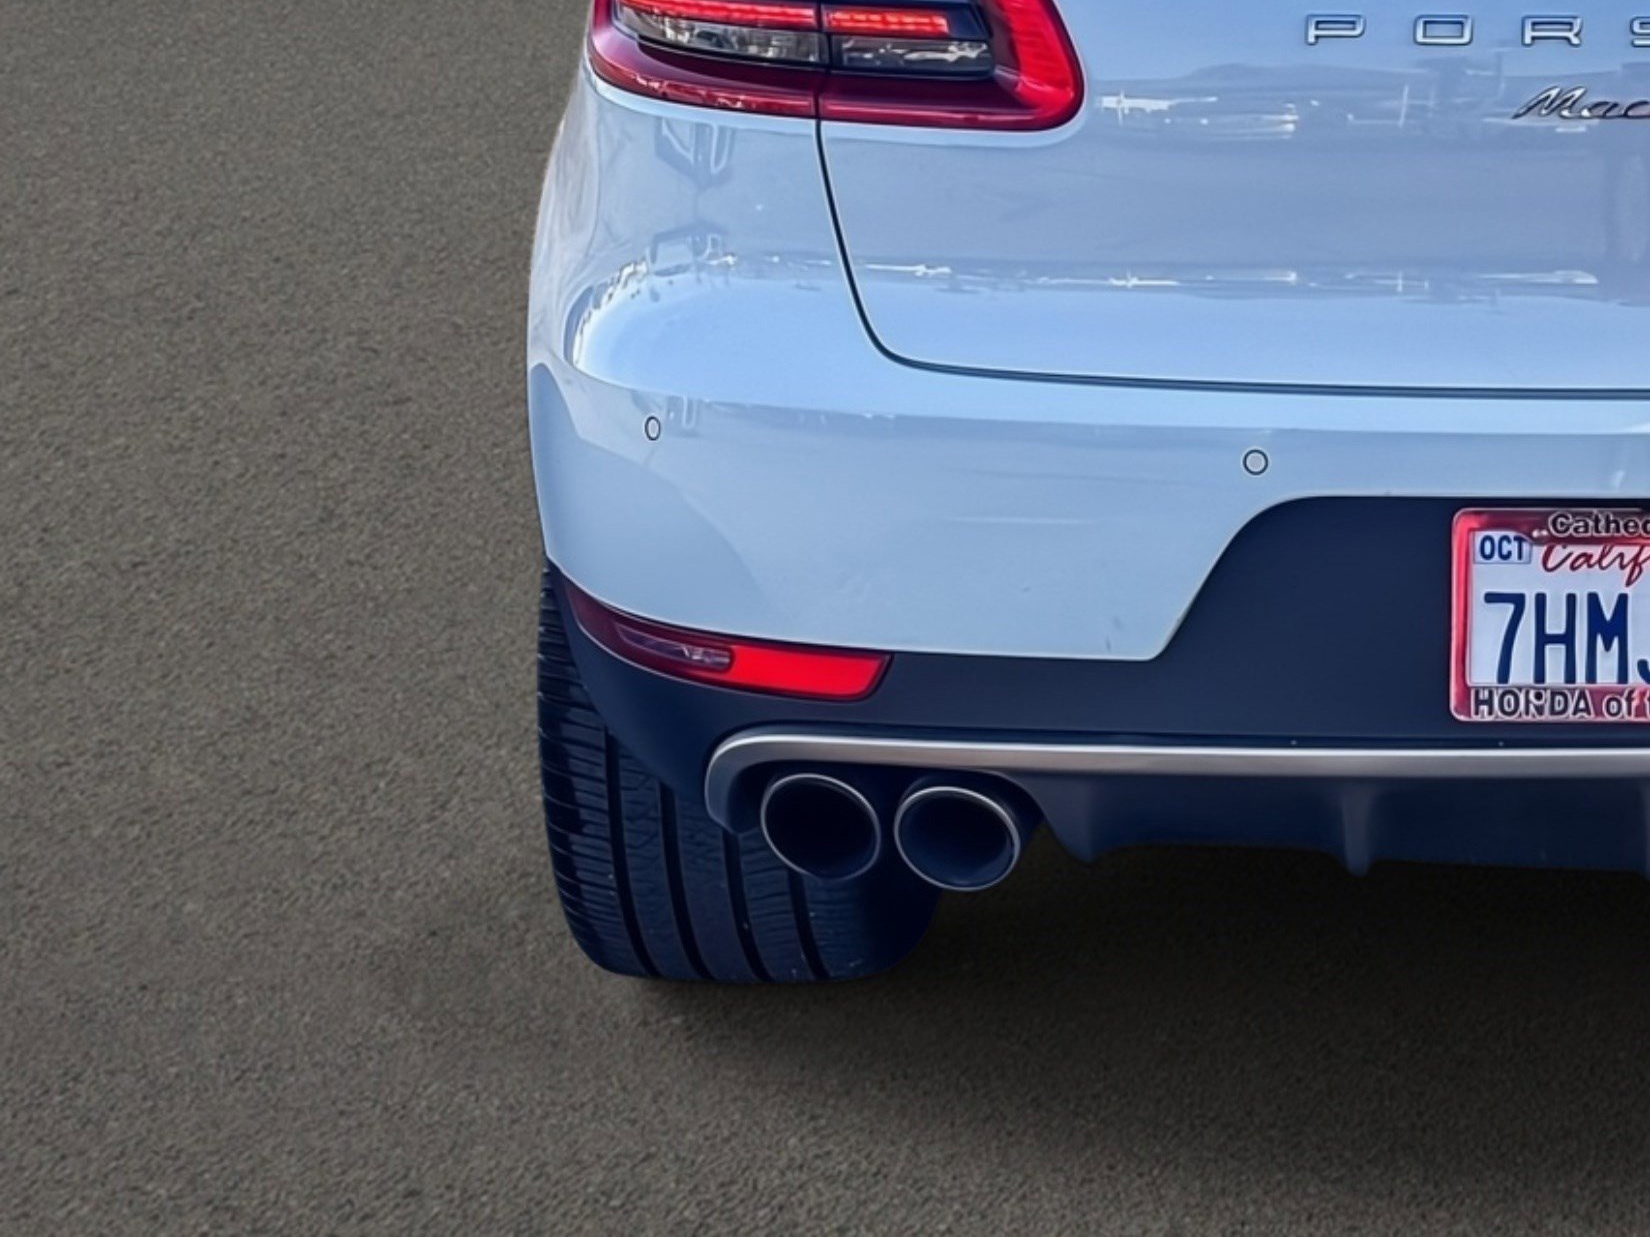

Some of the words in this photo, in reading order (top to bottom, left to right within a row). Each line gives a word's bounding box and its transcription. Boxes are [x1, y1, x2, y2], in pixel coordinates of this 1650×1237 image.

[1479, 534, 1526, 561] OCT
[1472, 688, 1594, 719] HONDA
[1604, 688, 1639, 719] of
